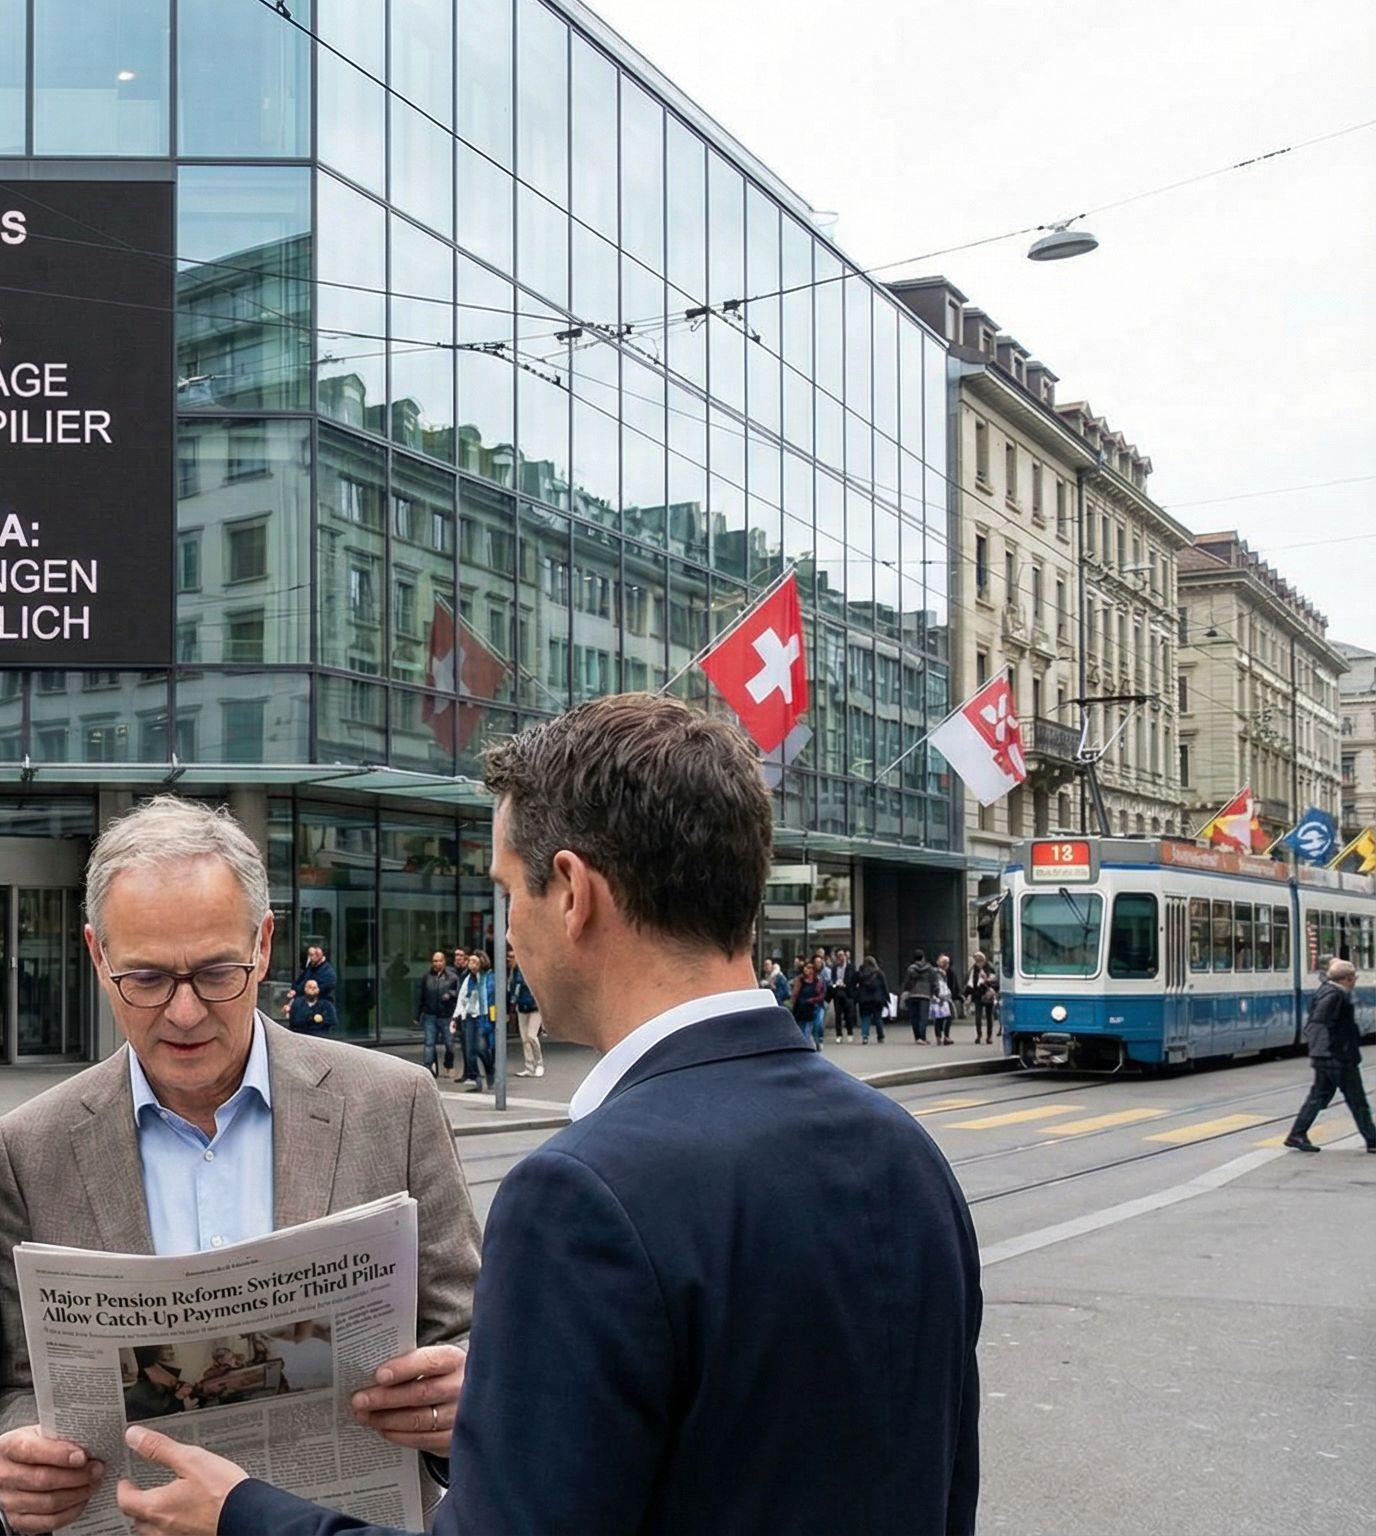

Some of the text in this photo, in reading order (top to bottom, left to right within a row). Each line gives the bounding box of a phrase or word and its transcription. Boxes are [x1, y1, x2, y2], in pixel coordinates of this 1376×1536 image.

[40, 1288, 91, 1308] Major
[97, 1292, 166, 1307] Pension
[171, 1284, 243, 1306] Reform:
[247, 1254, 348, 1293] Switzerland
[353, 1253, 371, 1267] to
[42, 1306, 92, 1324] Allow
[96, 1310, 178, 1328] Catch-Up
[183, 1298, 268, 1324] Payments
[272, 1289, 297, 1306] for
[300, 1274, 348, 1298] Third
[352, 1262, 397, 1286] Pillar
